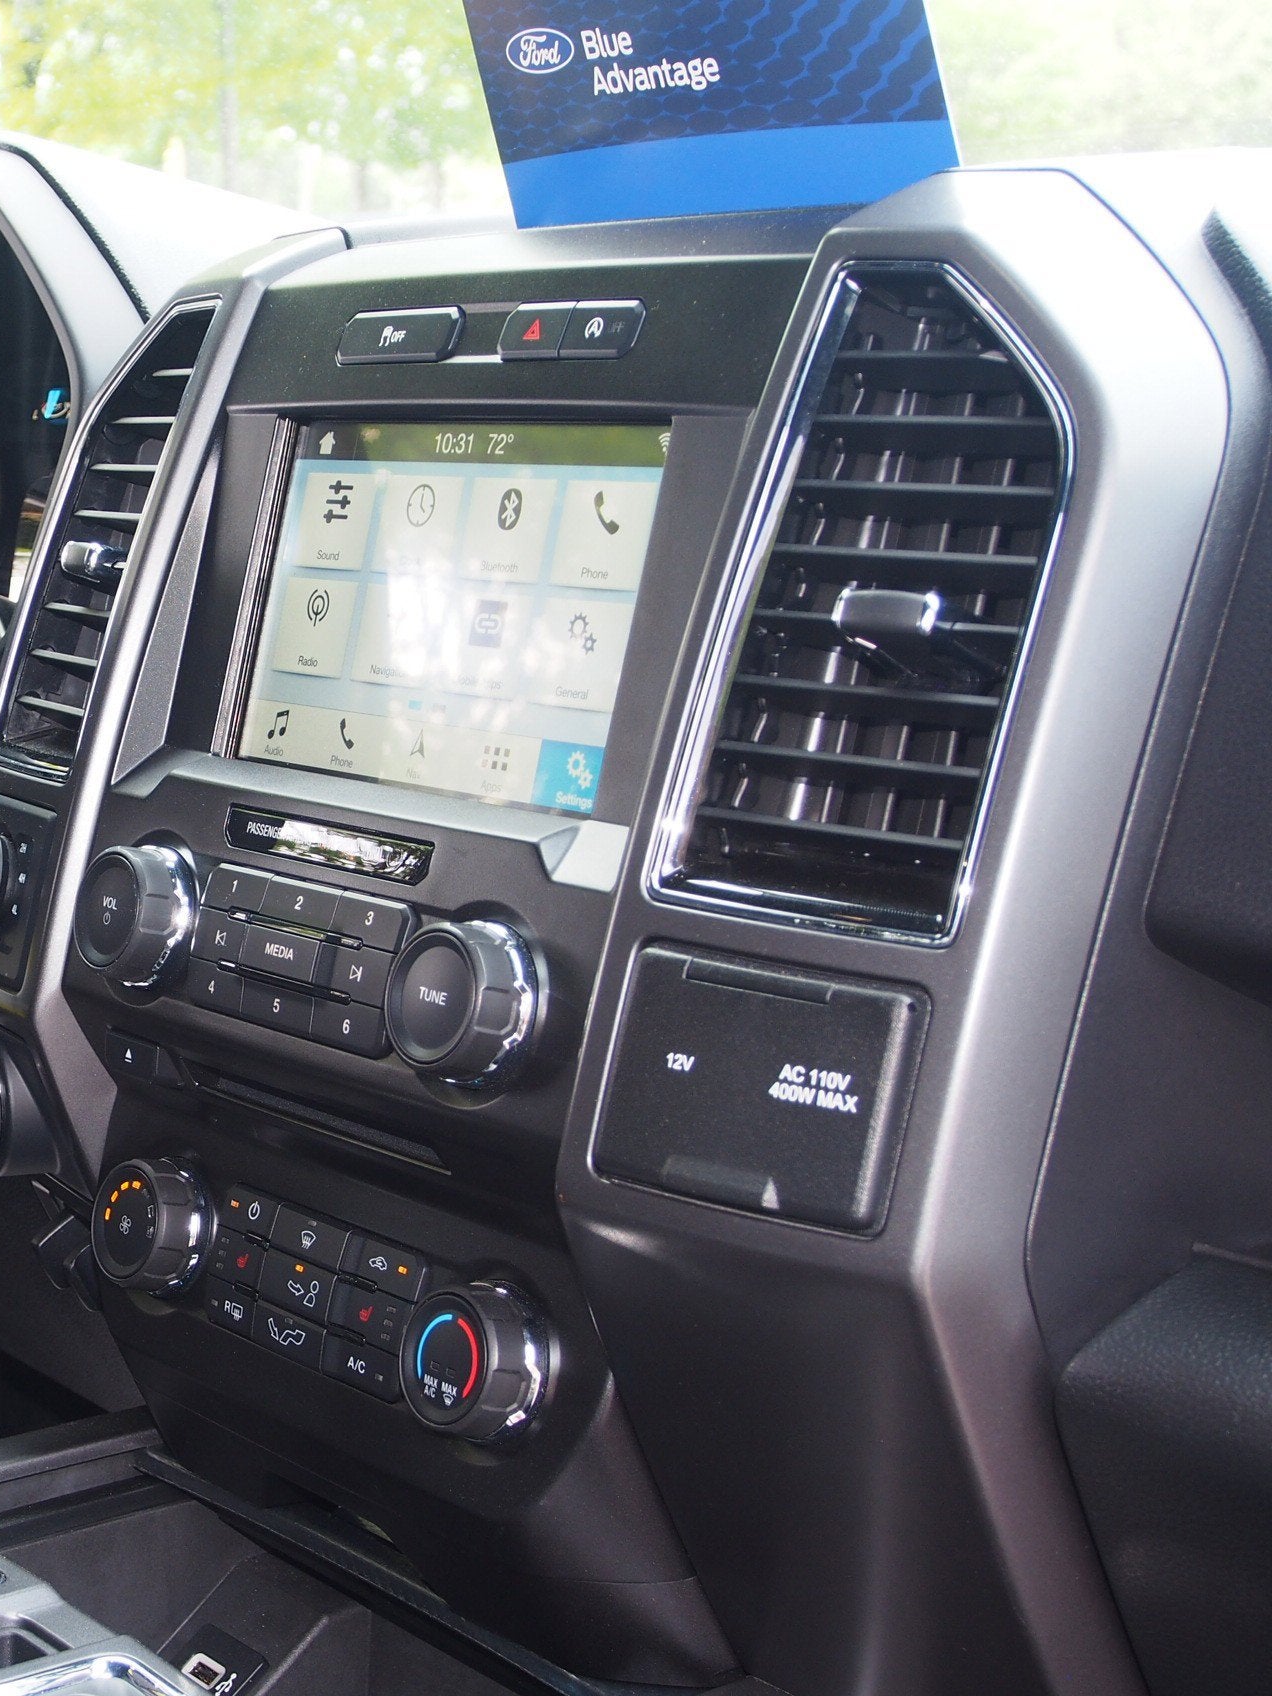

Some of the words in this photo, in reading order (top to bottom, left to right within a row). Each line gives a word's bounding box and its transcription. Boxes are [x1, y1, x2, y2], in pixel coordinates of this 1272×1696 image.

[519, 35, 561, 66] Ford
[580, 28, 633, 60] Blue
[592, 57, 721, 96] Advantage
[390, 330, 406, 343] OFF
[434, 432, 475, 454] 10:31
[316, 549, 340, 561] Sound
[580, 566, 609, 581] Phone
[297, 655, 319, 668] Radio
[555, 685, 589, 700] General
[264, 744, 284, 757] Audio
[329, 754, 353, 769] Phone
[480, 779, 503, 794] Apps
[555, 790, 594, 810] Settings
[246, 821, 285, 841] PASSENGE
[232, 879, 239, 895] 1
[102, 895, 118, 911] VOL
[294, 895, 304, 911] 2
[365, 911, 374, 926] 3
[264, 941, 294, 961] MEDIA
[207, 979, 215, 995] 4
[418, 985, 448, 1006] TUNE
[272, 998, 281, 1013] 5
[342, 1019, 350, 1034] 6
[665, 1051, 696, 1072] 12V
[778, 1063, 806, 1083] AC
[808, 1068, 852, 1092] 110V
[768, 1082, 816, 1105] 400W
[815, 1090, 859, 1113] MAX
[347, 1355, 366, 1375] A/C
[424, 1373, 439, 1389] MAX
[441, 1381, 458, 1397] MAX
[424, 1384, 436, 1398] A/C
